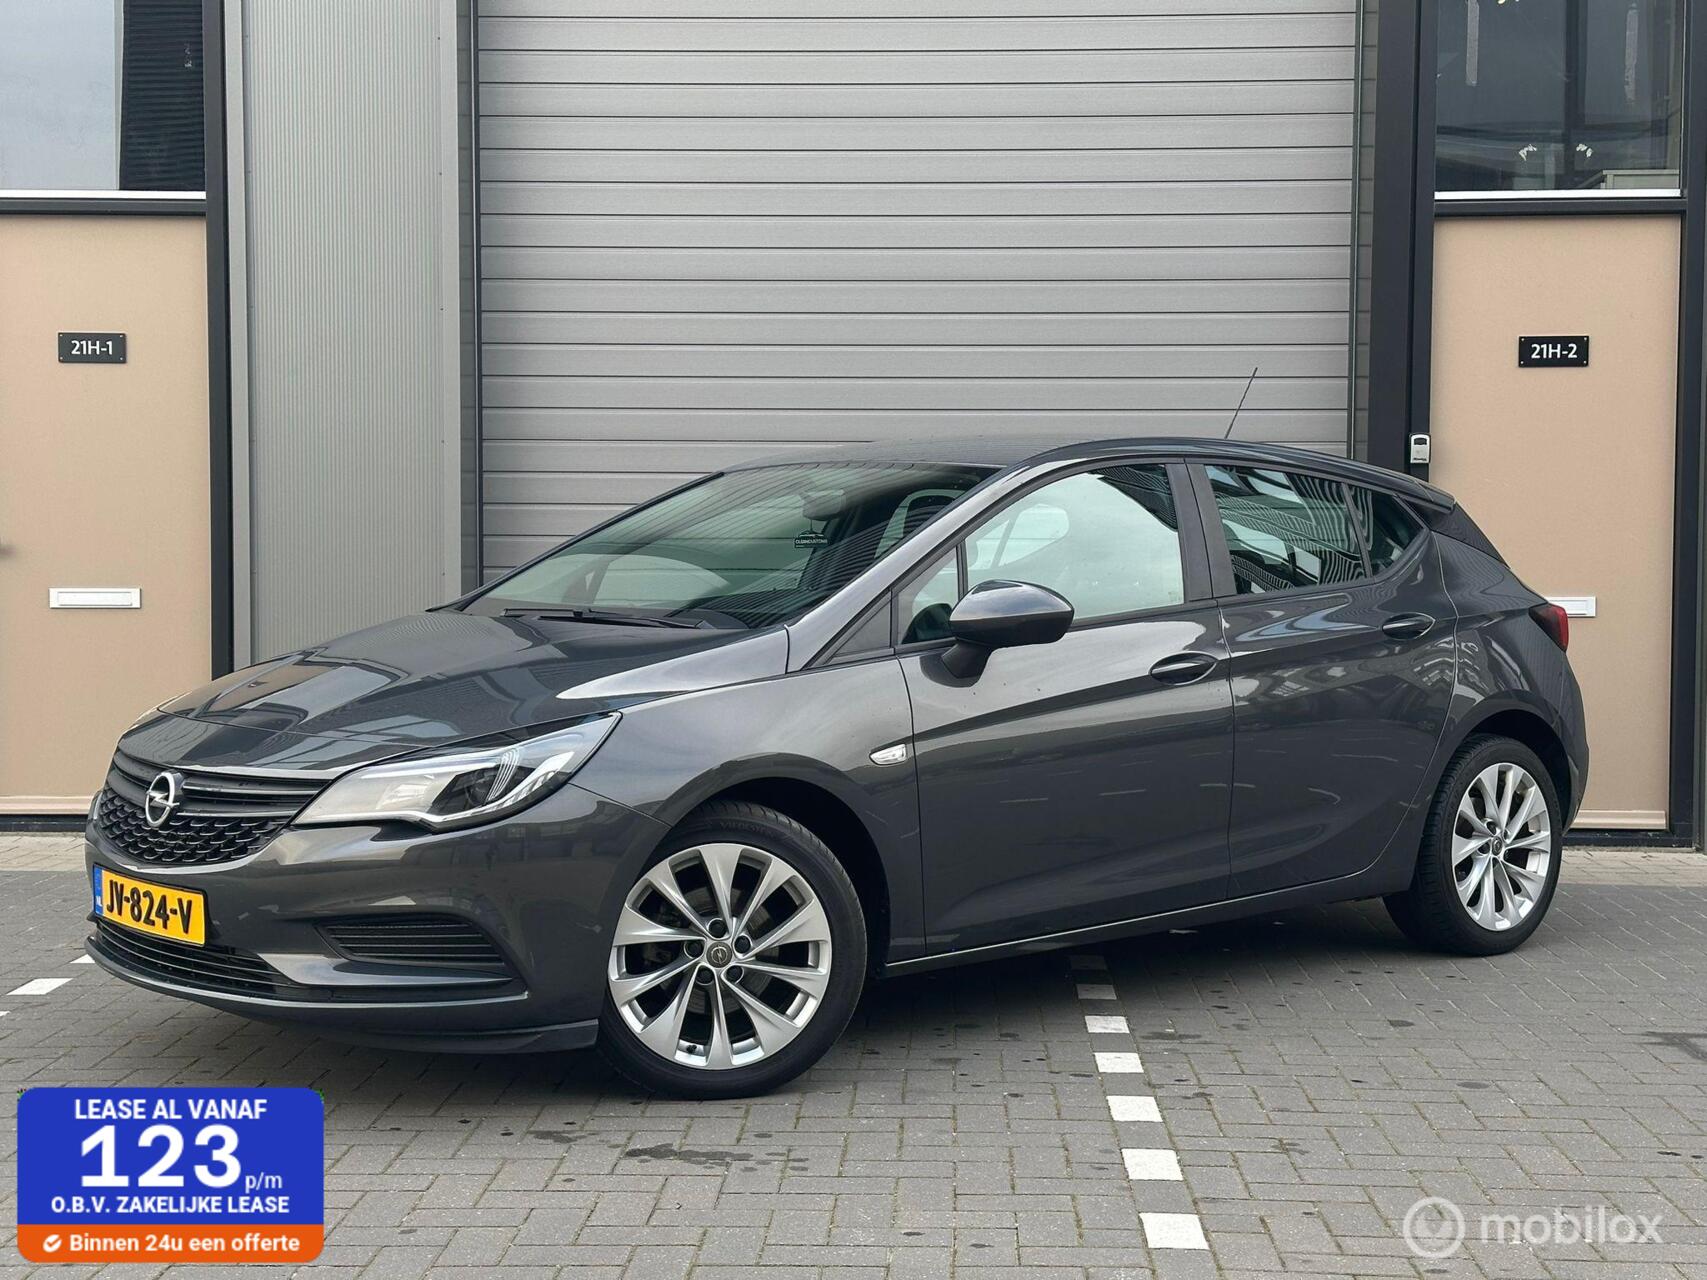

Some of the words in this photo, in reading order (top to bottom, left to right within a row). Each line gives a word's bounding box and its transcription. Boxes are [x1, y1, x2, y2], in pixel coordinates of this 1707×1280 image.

[71, 340, 112, 355] 21H-1
[1531, 344, 1577, 359] 21H-2
[106, 880, 192, 934] JV-824-V
